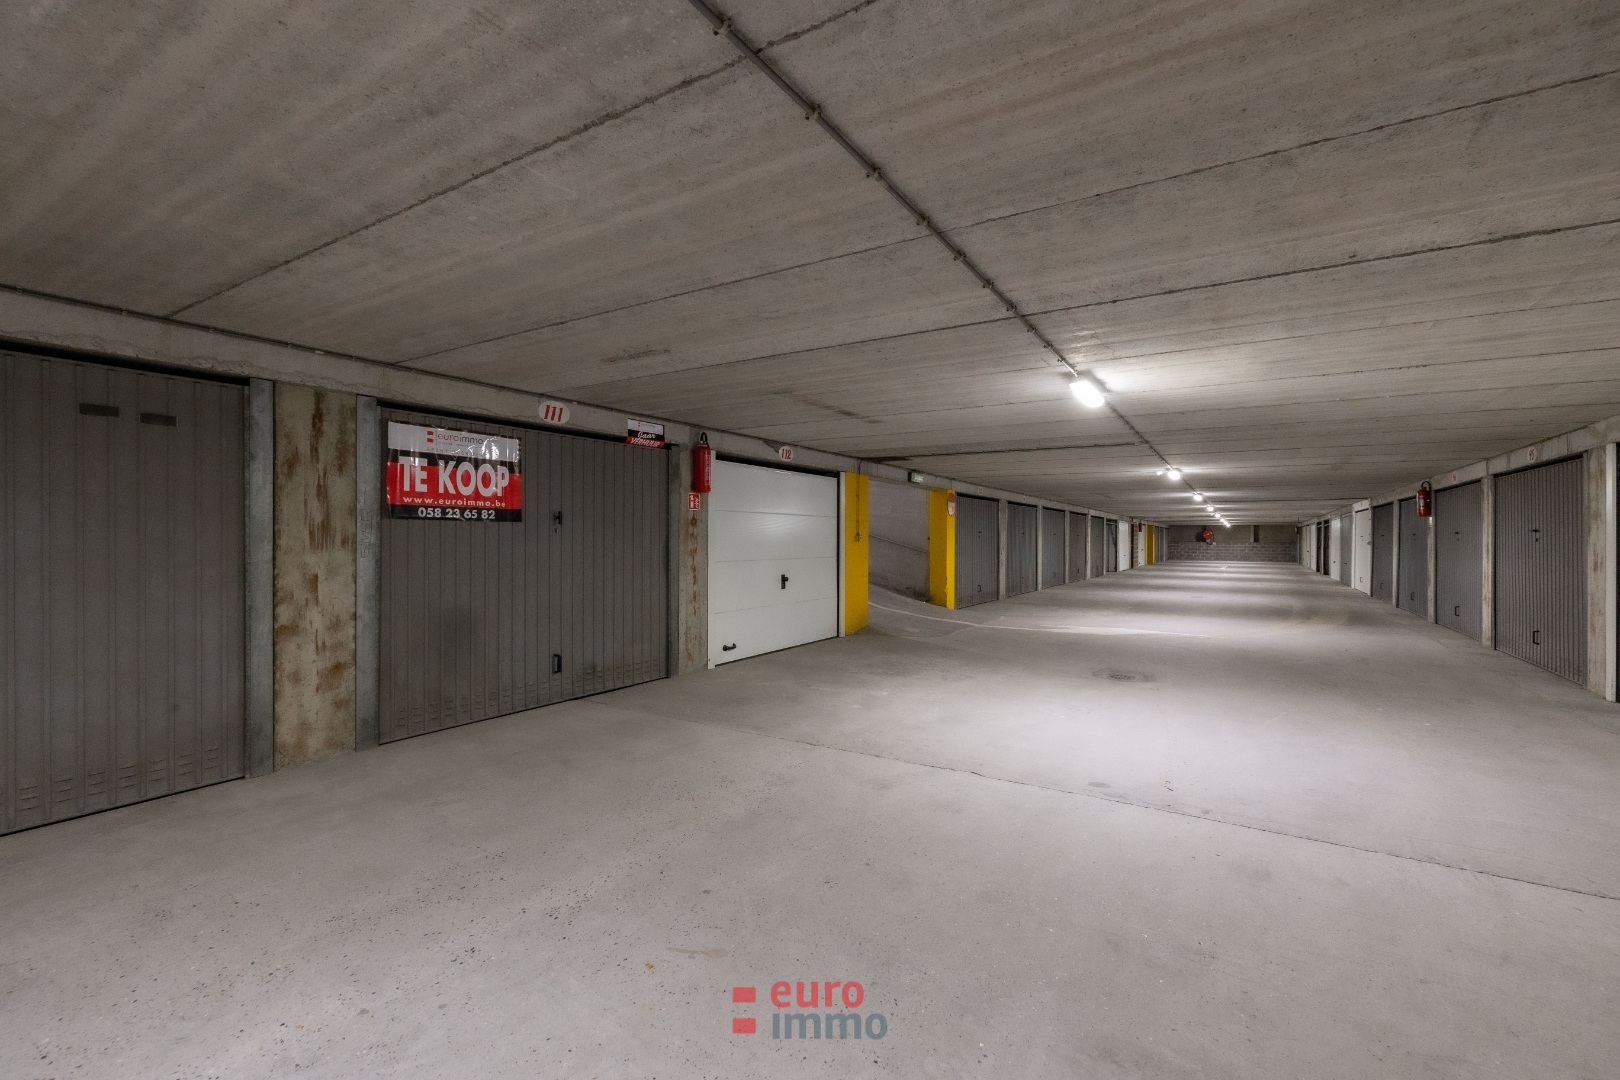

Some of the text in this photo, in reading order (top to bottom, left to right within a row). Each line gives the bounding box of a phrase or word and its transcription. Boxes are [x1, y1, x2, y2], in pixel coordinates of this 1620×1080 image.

[544, 404, 563, 423] 111
[437, 433, 484, 445] euroimmo
[781, 448, 792, 460] 112
[399, 456, 510, 497] TE KOOP
[402, 496, 506, 508] www.euroimmo.be
[418, 507, 496, 520] 058 23 65 82
